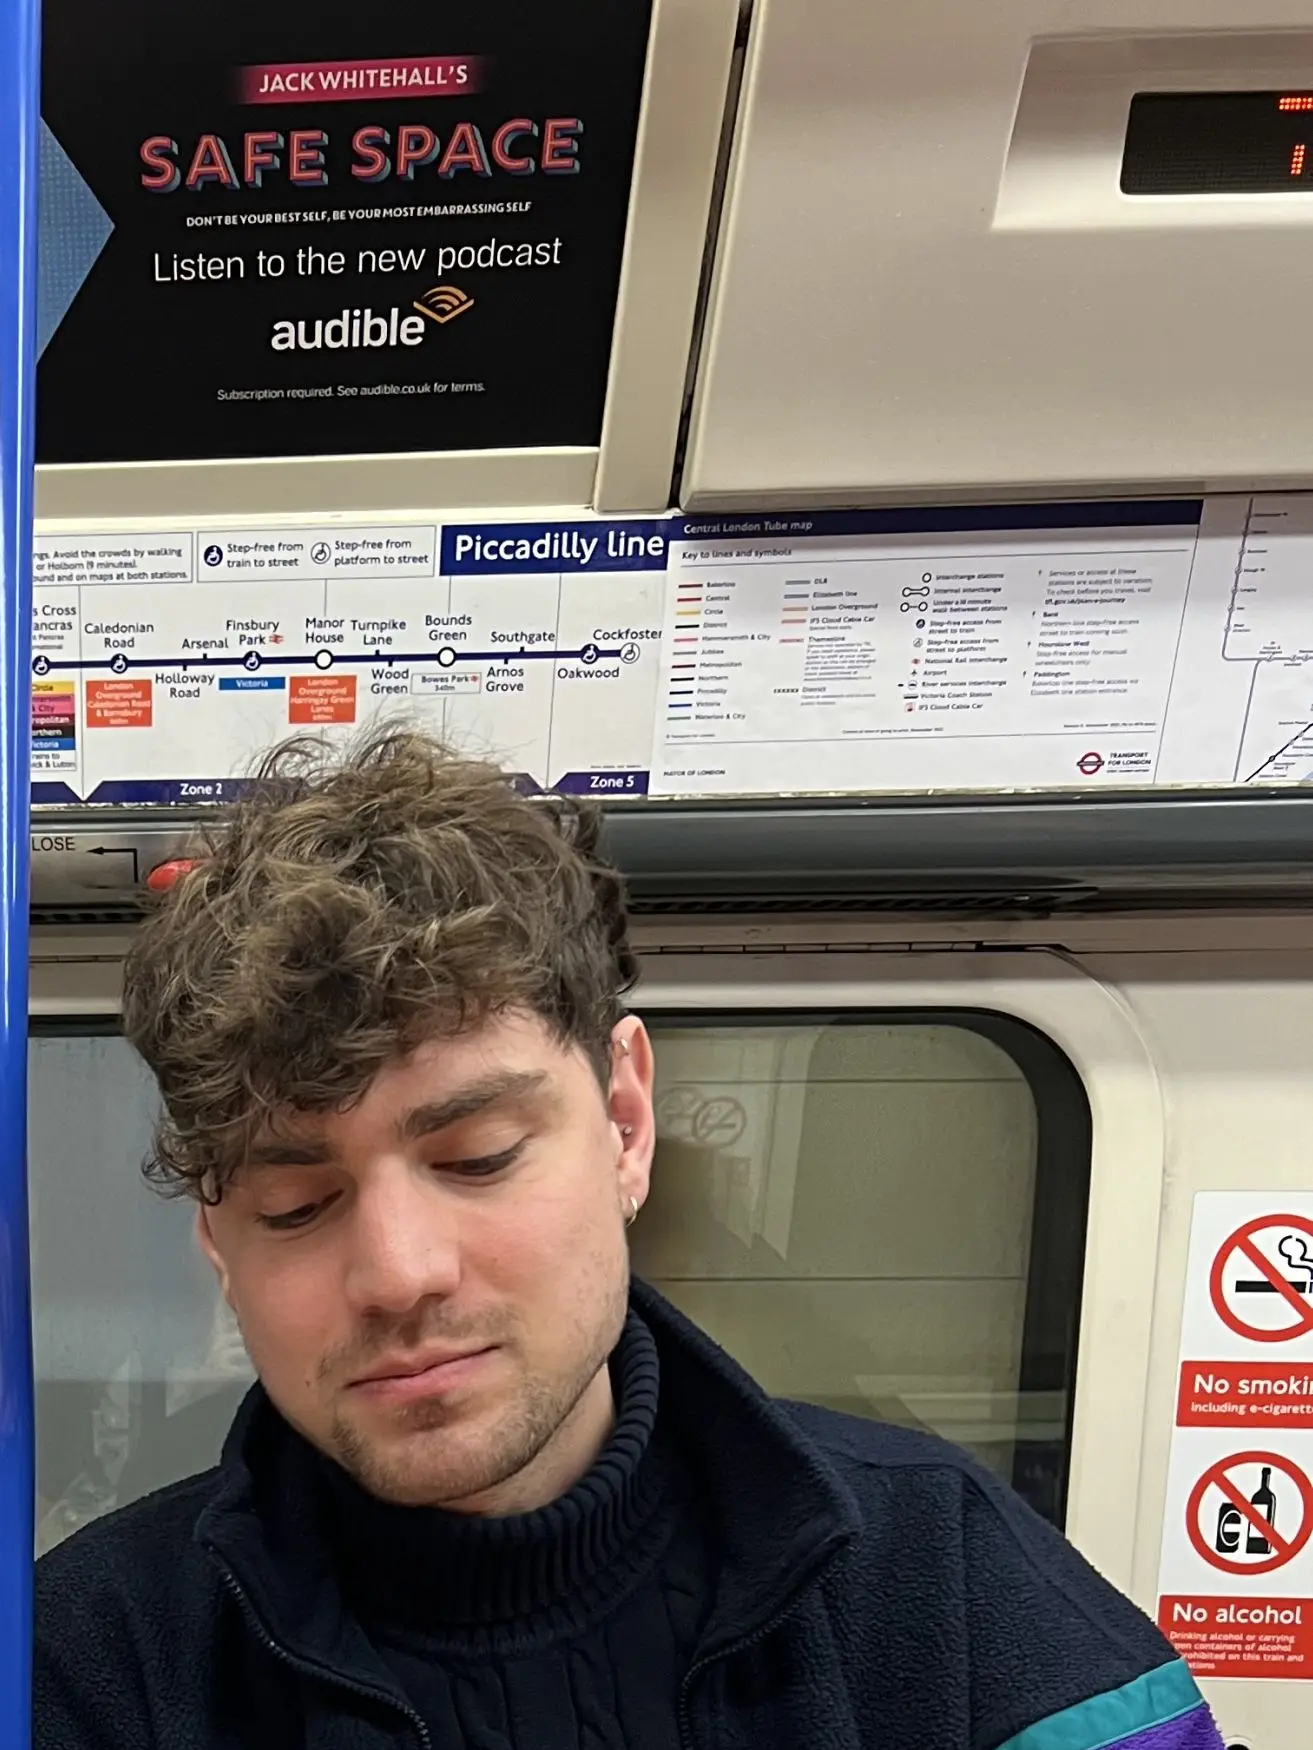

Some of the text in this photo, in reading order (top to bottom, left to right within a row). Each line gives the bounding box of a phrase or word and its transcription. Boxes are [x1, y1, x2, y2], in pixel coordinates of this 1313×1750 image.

[258, 64, 469, 94] JACK WHITEHALL'S
[139, 117, 584, 195] SAFE SPACE
[186, 201, 532, 227] DON'T BE YOUR BEST SELF, BE YOUR MOST EMBARRASSING SELF
[153, 237, 563, 282] Listen to the new podcast
[270, 308, 426, 351] audible
[217, 381, 486, 401] Subscription required. See audible.co.uk for terms.
[683, 521, 813, 535] Central London Tube map
[227, 542, 304, 554] Step-free from
[335, 539, 412, 552] Step-free from
[455, 531, 664, 564] Piccadilly line
[334, 554, 429, 567] platform to street
[681, 552, 698, 560] Key
[711, 550, 734, 558] lines
[735, 549, 752, 557] and
[754, 548, 792, 558] symbols
[227, 557, 299, 568] train to street
[226, 619, 280, 633] Finsbury
[305, 617, 345, 629] Manor
[350, 619, 407, 632] Turnpike
[425, 614, 472, 627] Bounds
[84, 621, 154, 634] Caledonian
[239, 633, 266, 645] Park
[305, 632, 344, 643] House
[363, 634, 393, 646] Lane
[429, 629, 467, 641] Green
[490, 630, 556, 643] Southgate
[104, 636, 135, 649] Road
[181, 638, 229, 649] Arsenal
[371, 668, 410, 680] Wood
[486, 666, 524, 677] Arnos
[557, 667, 620, 680] Oakwood
[155, 673, 215, 686] Holloway
[170, 686, 200, 698] Road
[370, 682, 408, 694] Green
[485, 681, 524, 692] Grove
[1194, 1374, 1230, 1394] No
[1191, 1402, 1246, 1415] including
[1173, 1602, 1302, 1624] No alcohol
[1169, 1631, 1207, 1641] Drinking
[1209, 1632, 1244, 1641] alcohol
[1258, 1634, 1295, 1643] carrying
[1194, 1642, 1292, 1652] containers of alcohol
